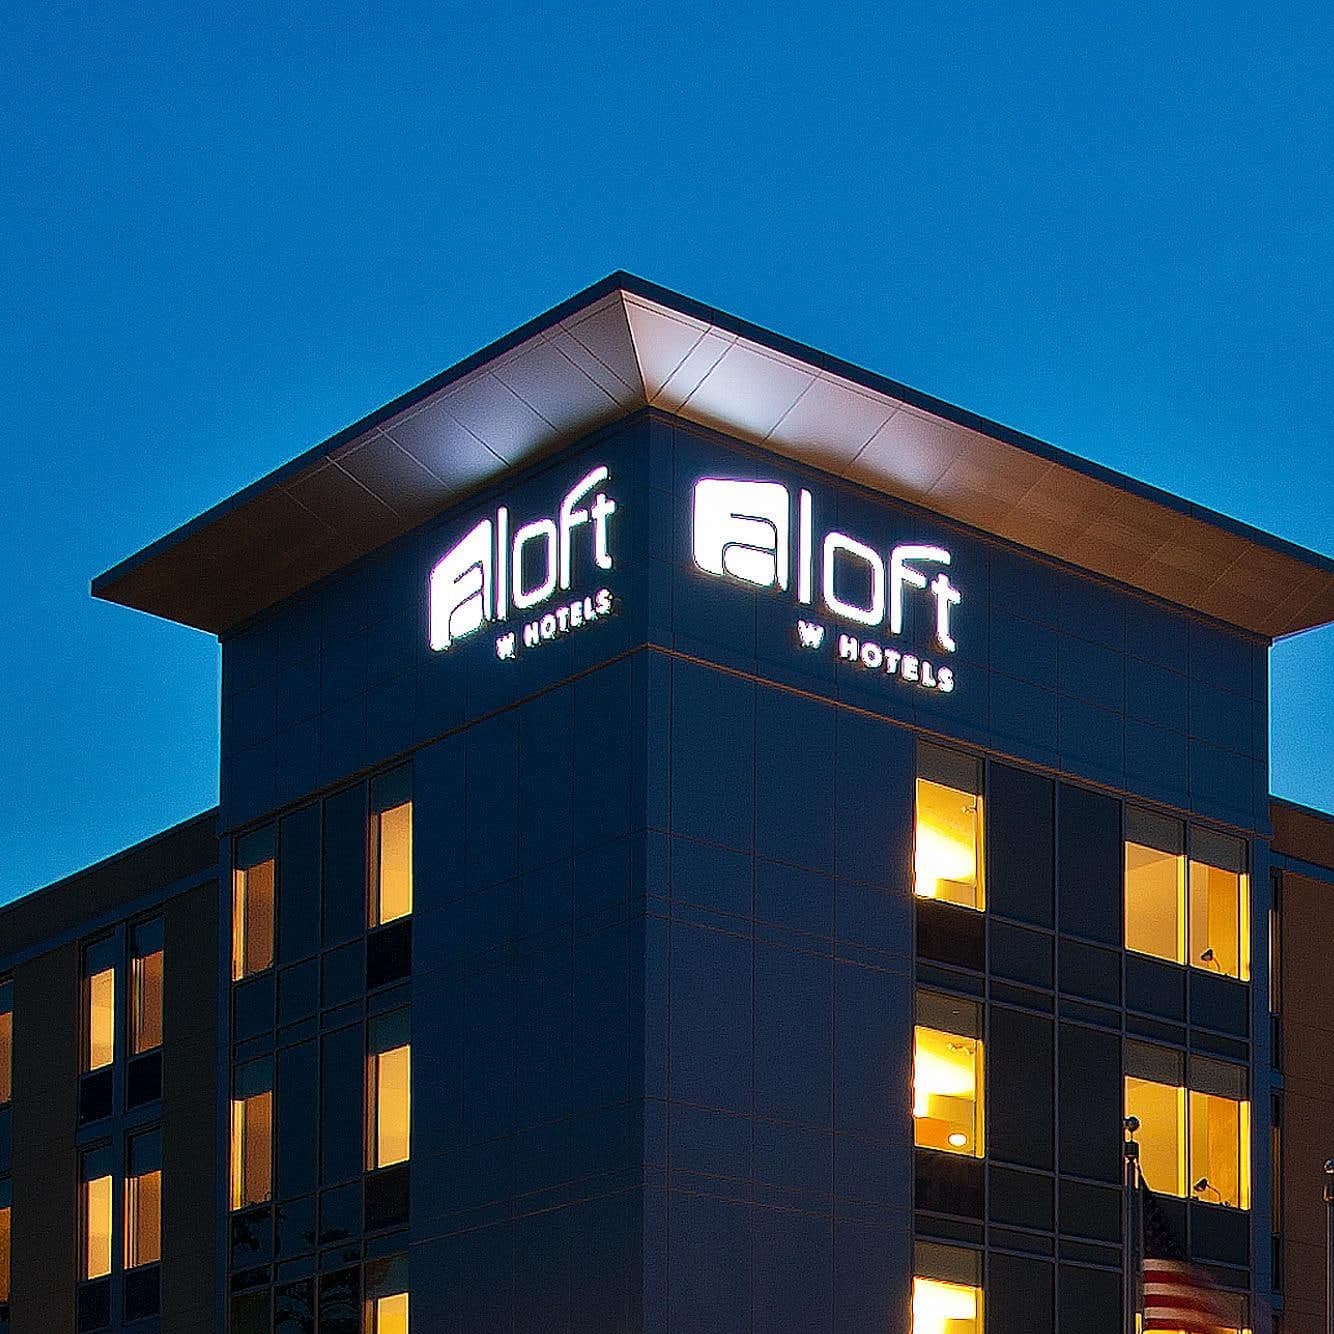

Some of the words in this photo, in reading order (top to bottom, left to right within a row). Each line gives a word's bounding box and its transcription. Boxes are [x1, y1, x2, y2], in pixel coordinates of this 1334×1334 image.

[430, 465, 616, 651] aloft
[692, 478, 961, 652] aloft
[496, 632, 516, 660] W
[523, 588, 613, 648] HOTELS
[798, 620, 825, 649] W
[839, 634, 955, 693] HOTELS
